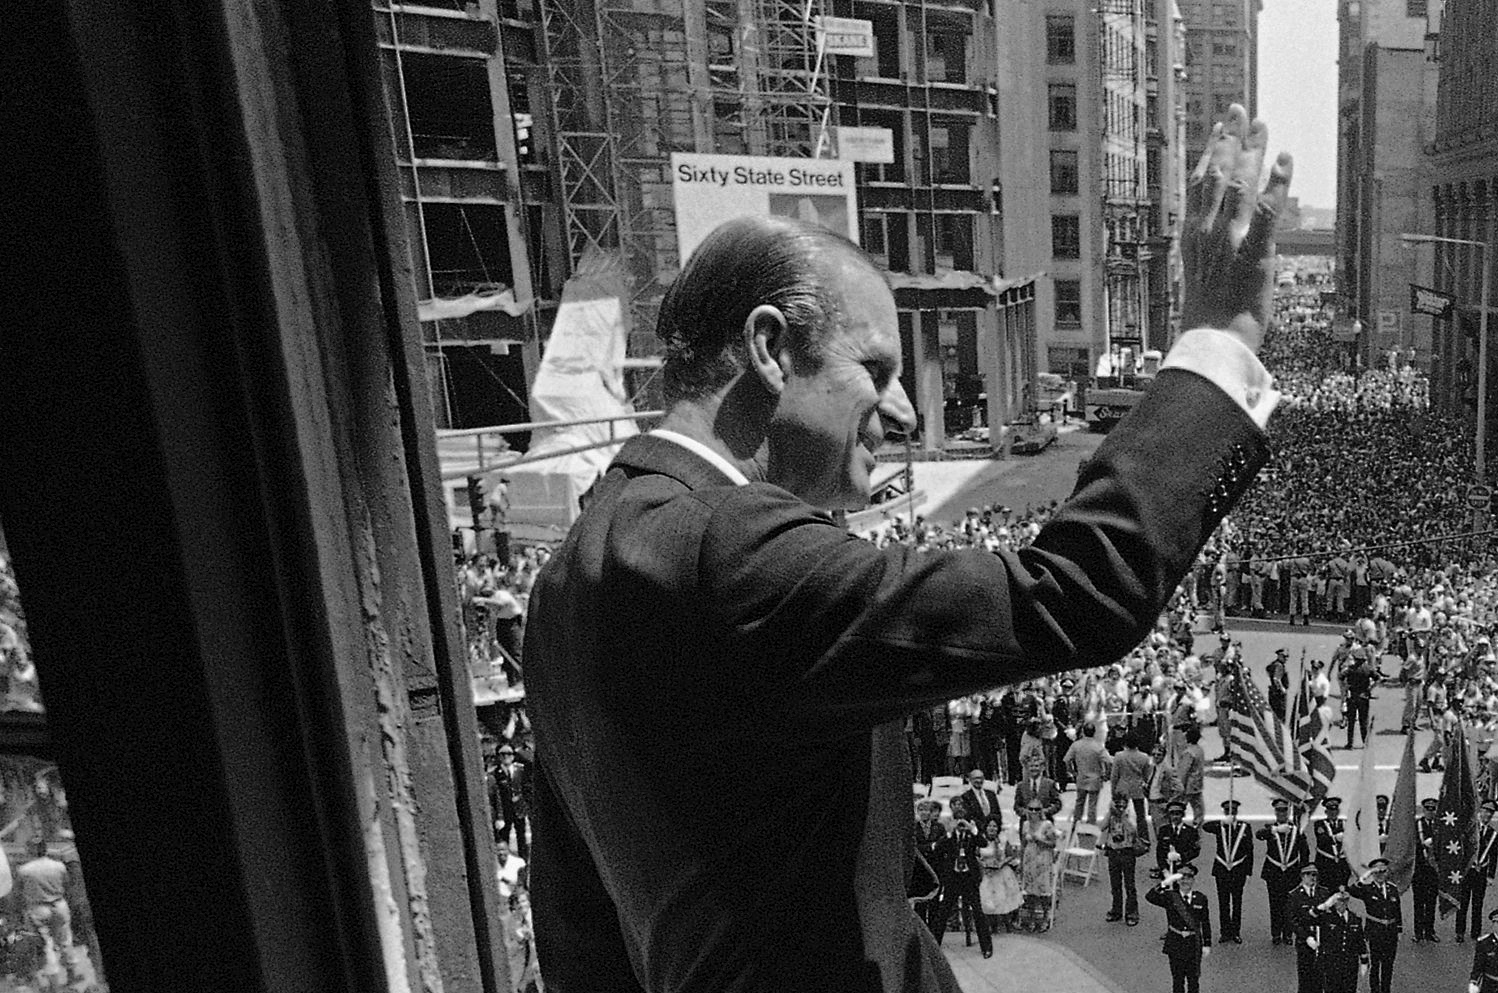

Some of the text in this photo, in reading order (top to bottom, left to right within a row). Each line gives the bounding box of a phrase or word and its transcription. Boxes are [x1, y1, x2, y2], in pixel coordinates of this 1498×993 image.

[678, 164, 844, 188] Sixty State Street
